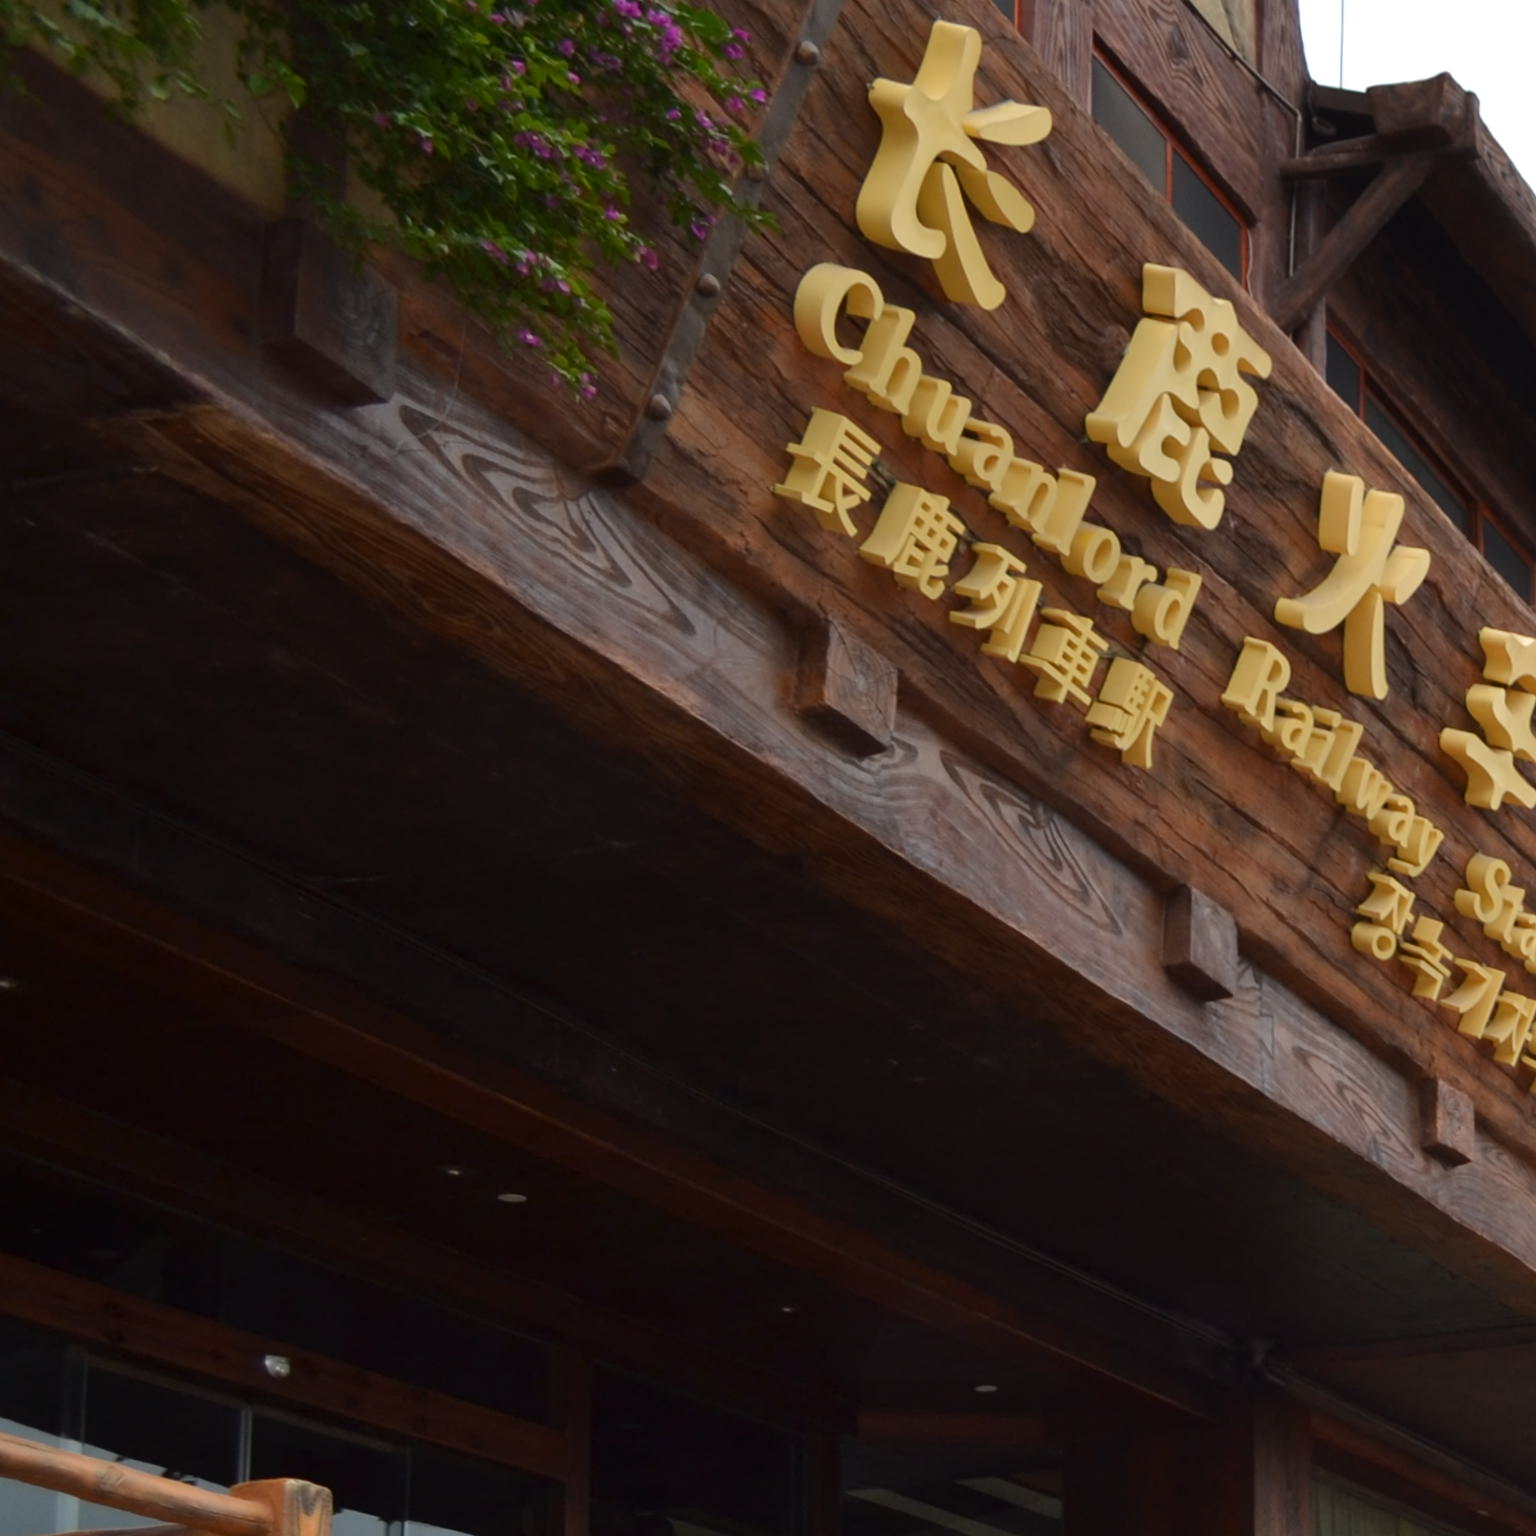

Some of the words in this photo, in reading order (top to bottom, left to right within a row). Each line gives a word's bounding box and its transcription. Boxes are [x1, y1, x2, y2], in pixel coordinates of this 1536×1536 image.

[772, 406, 1174, 769] 長鹿列車駅
[794, 262, 1202, 650] Chuanlord
[1221, 635, 1444, 877] Railway
